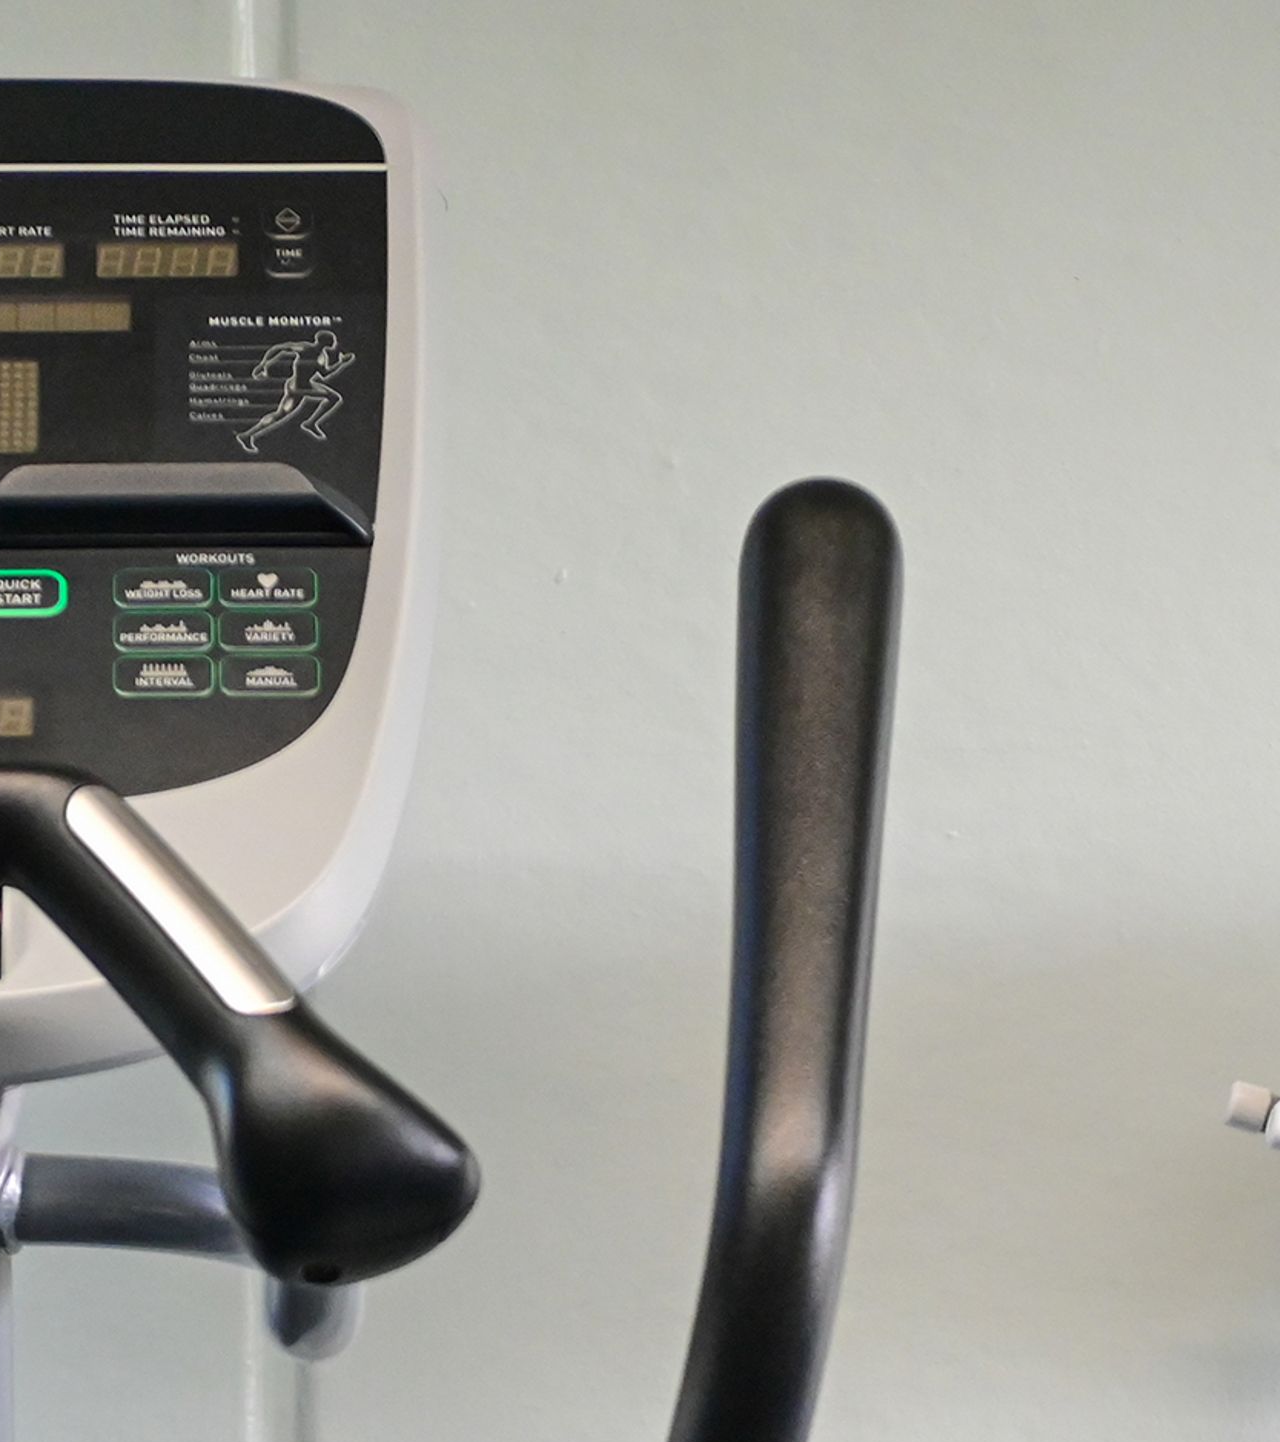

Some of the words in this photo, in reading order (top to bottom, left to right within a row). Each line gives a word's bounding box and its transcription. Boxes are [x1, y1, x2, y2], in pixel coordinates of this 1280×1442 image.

[113, 214, 146, 225] TIME
[149, 214, 210, 225] ELAPSED
[18, 225, 53, 237] RATE
[112, 226, 146, 237] TIME
[149, 226, 226, 237] REMAINING
[275, 248, 303, 258] TIME
[208, 316, 265, 327] MUSCLE
[176, 553, 256, 565] WORKOUTS
[124, 588, 170, 599] WEIGHT
[172, 588, 203, 599] LOSS
[230, 588, 271, 599] HEART
[274, 588, 305, 599] RATE
[119, 632, 208, 643] PERFORMANCE
[245, 632, 296, 642] VARIETY
[135, 677, 195, 688] INTERVAL
[245, 677, 297, 688] MANUAL
